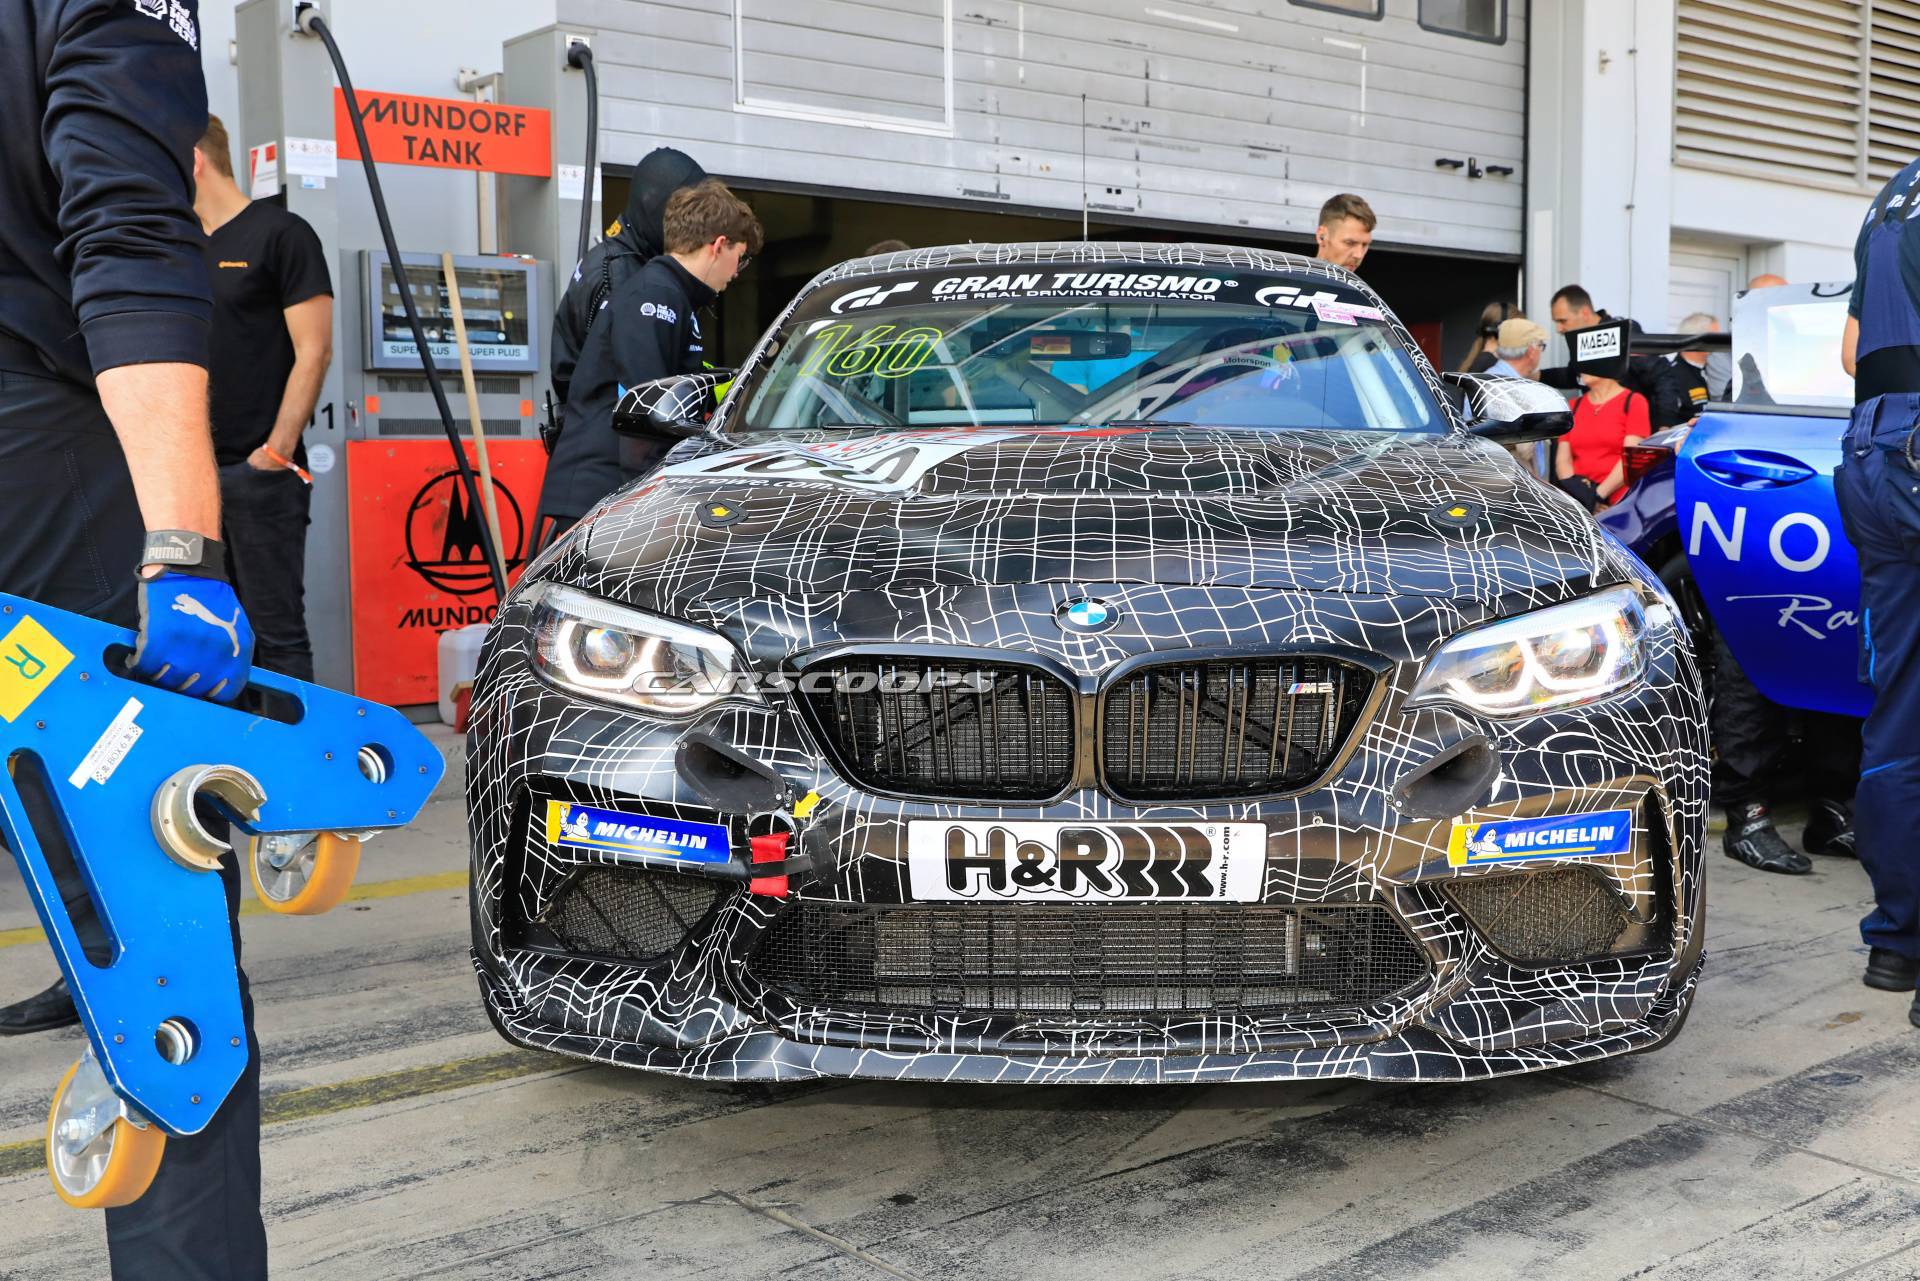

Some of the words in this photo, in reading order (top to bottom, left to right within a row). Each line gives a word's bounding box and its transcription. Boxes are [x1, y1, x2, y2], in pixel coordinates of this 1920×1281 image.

[361, 98, 526, 136] MUNDORF
[403, 135, 482, 165] TANK
[931, 274, 1043, 295] GRAN
[974, 291, 1021, 299] REAL
[1108, 290, 1216, 301] SIMULATOR
[390, 345, 420, 354] SUPE
[468, 348, 495, 356] UPER
[498, 349, 521, 357] PLUS
[799, 324, 943, 379] 160
[1580, 332, 1616, 351] MAEDA
[4, 643, 47, 680] R
[593, 821, 708, 850] MICHELIN
[1504, 825, 1615, 848] MICHELIN
[1218, 826, 1231, 897] www.h-r.com
